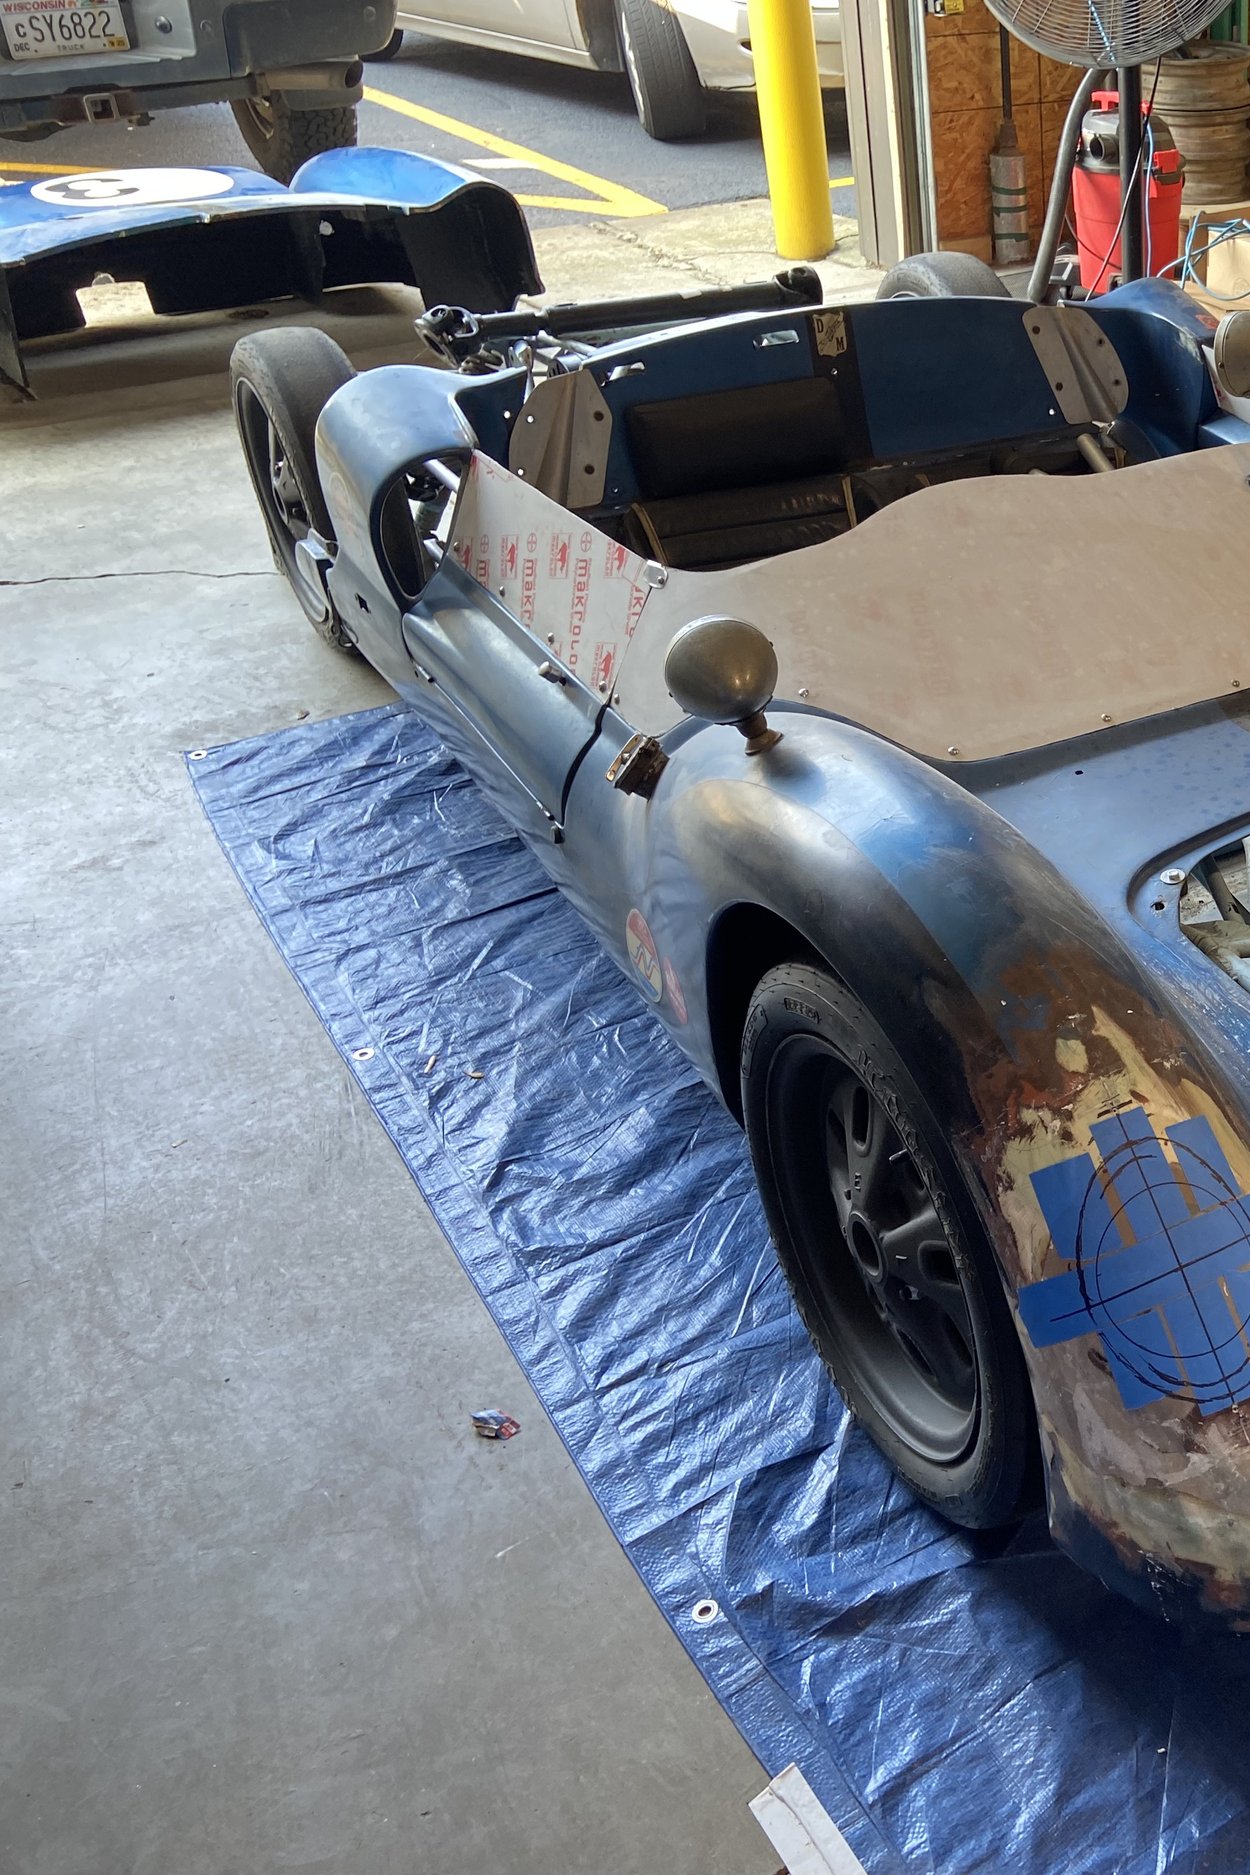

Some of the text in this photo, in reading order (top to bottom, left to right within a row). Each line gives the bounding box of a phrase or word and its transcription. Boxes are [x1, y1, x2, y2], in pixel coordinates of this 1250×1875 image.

[3, 0, 66, 12] WISCONSIN
[15, 10, 115, 42] C SY6822
[14, 42, 30, 52] DEC
